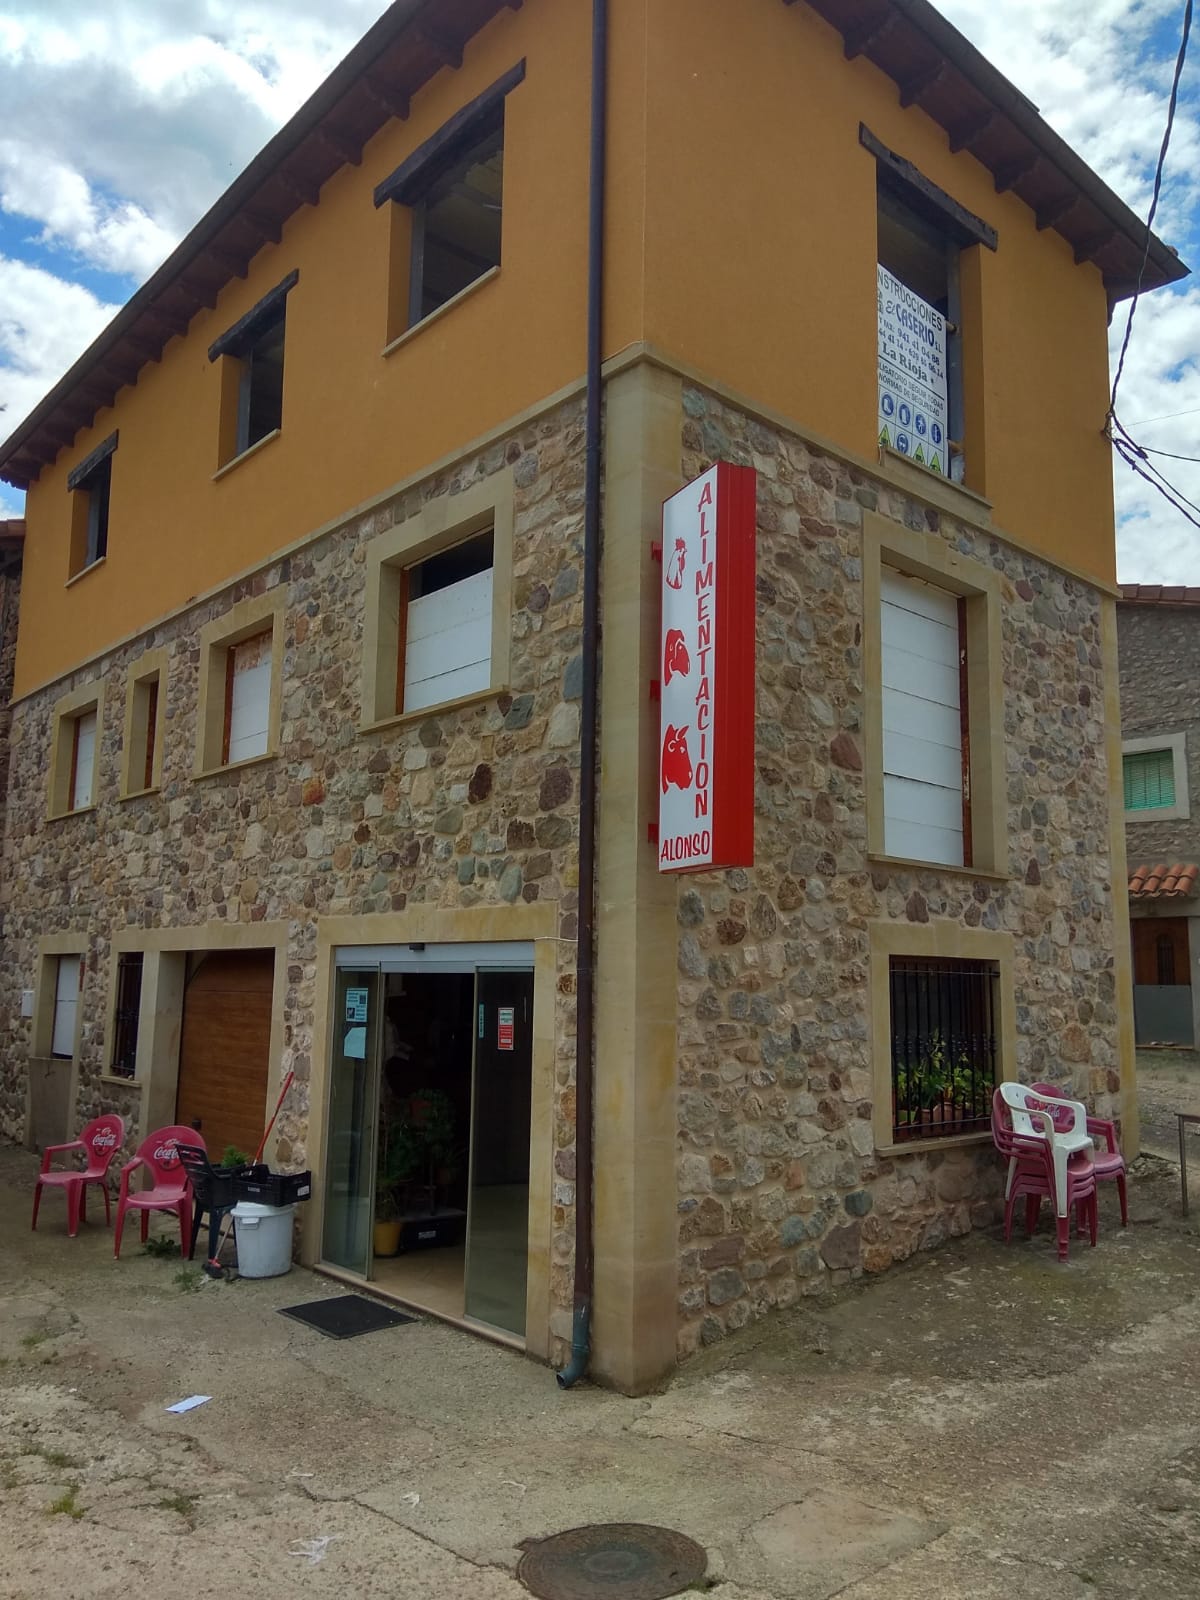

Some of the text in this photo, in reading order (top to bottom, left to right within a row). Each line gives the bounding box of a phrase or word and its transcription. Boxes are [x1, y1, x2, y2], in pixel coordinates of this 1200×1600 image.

[896, 303, 935, 347] CASERIO
[897, 328, 909, 343] 941
[882, 342, 927, 382] La Rioja
[694, 481, 713, 819] ALIMENTACION
[660, 830, 711, 861] ALONSO
